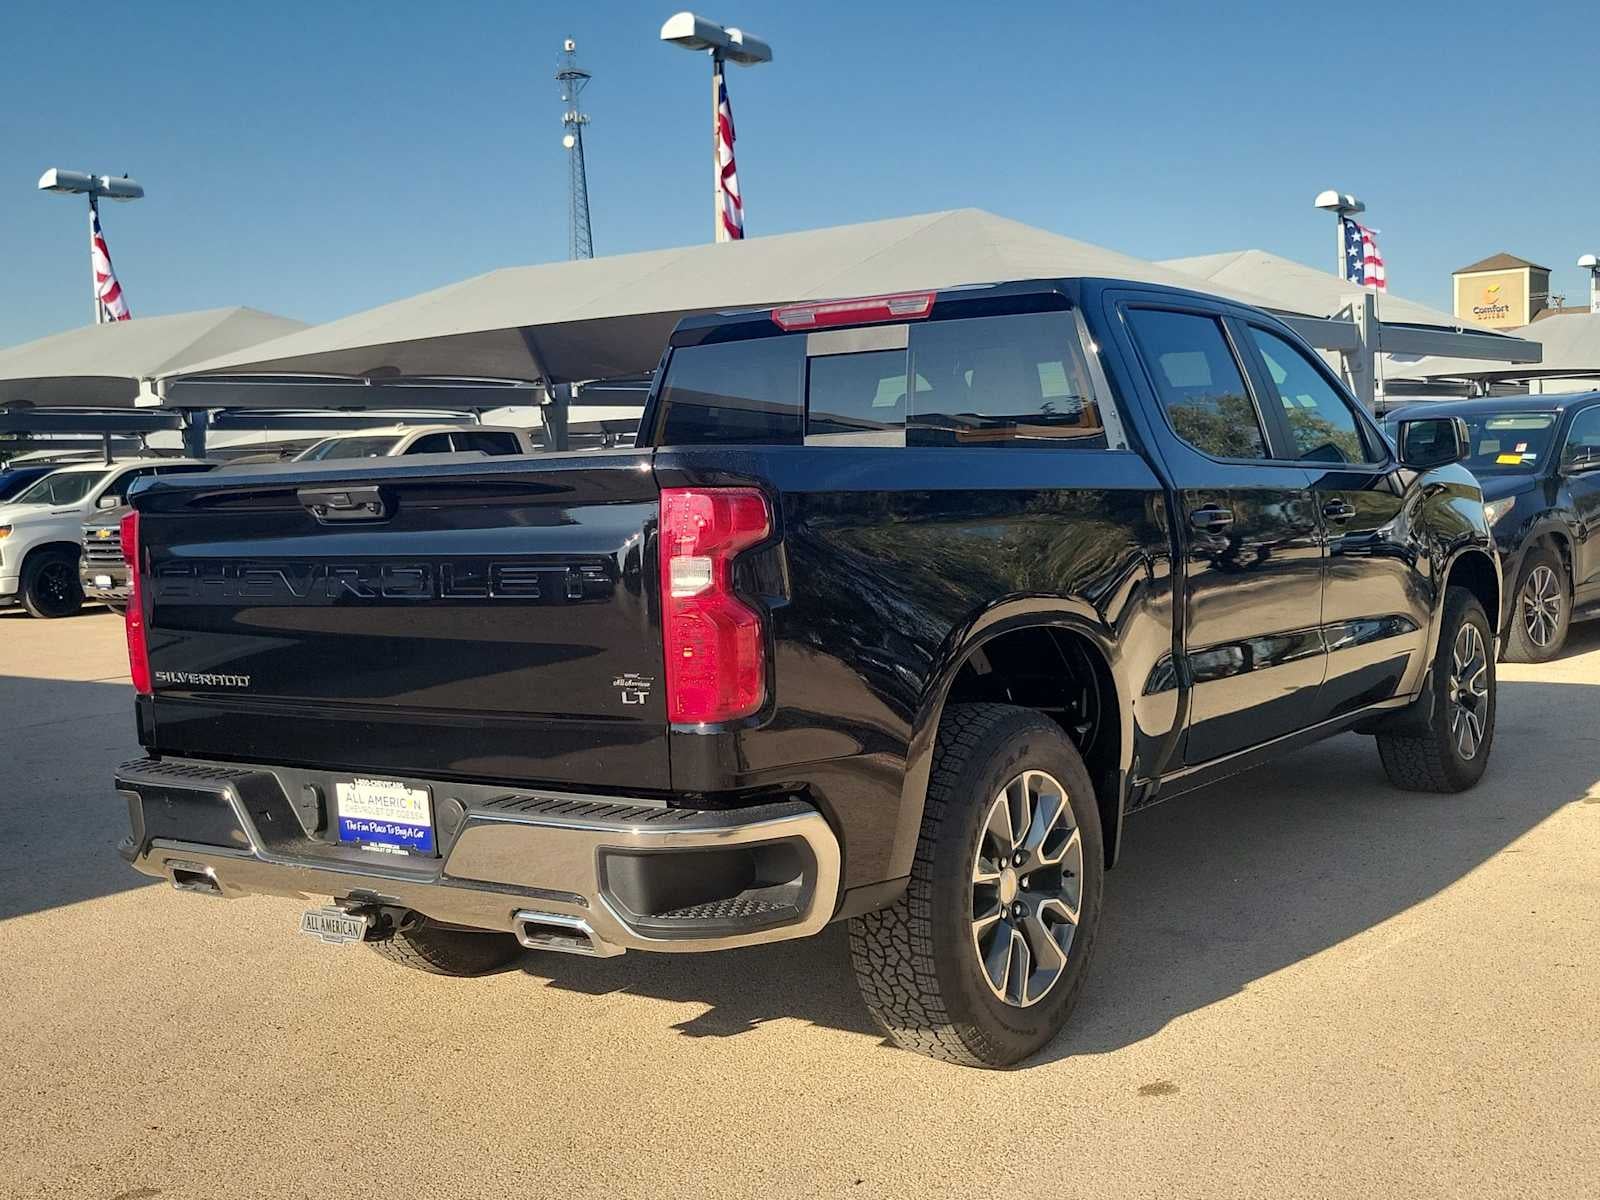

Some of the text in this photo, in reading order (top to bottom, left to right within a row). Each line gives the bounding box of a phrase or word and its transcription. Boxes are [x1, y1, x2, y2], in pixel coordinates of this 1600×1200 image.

[1472, 304, 1510, 314] Comfort
[155, 560, 612, 600] CHEVROLET
[155, 671, 251, 687] SILVERADO
[621, 691, 649, 704] LT
[346, 792, 365, 804] ALL
[345, 819, 357, 832] The
[407, 827, 414, 838] A
[306, 915, 360, 936] ALL AMERICAN
